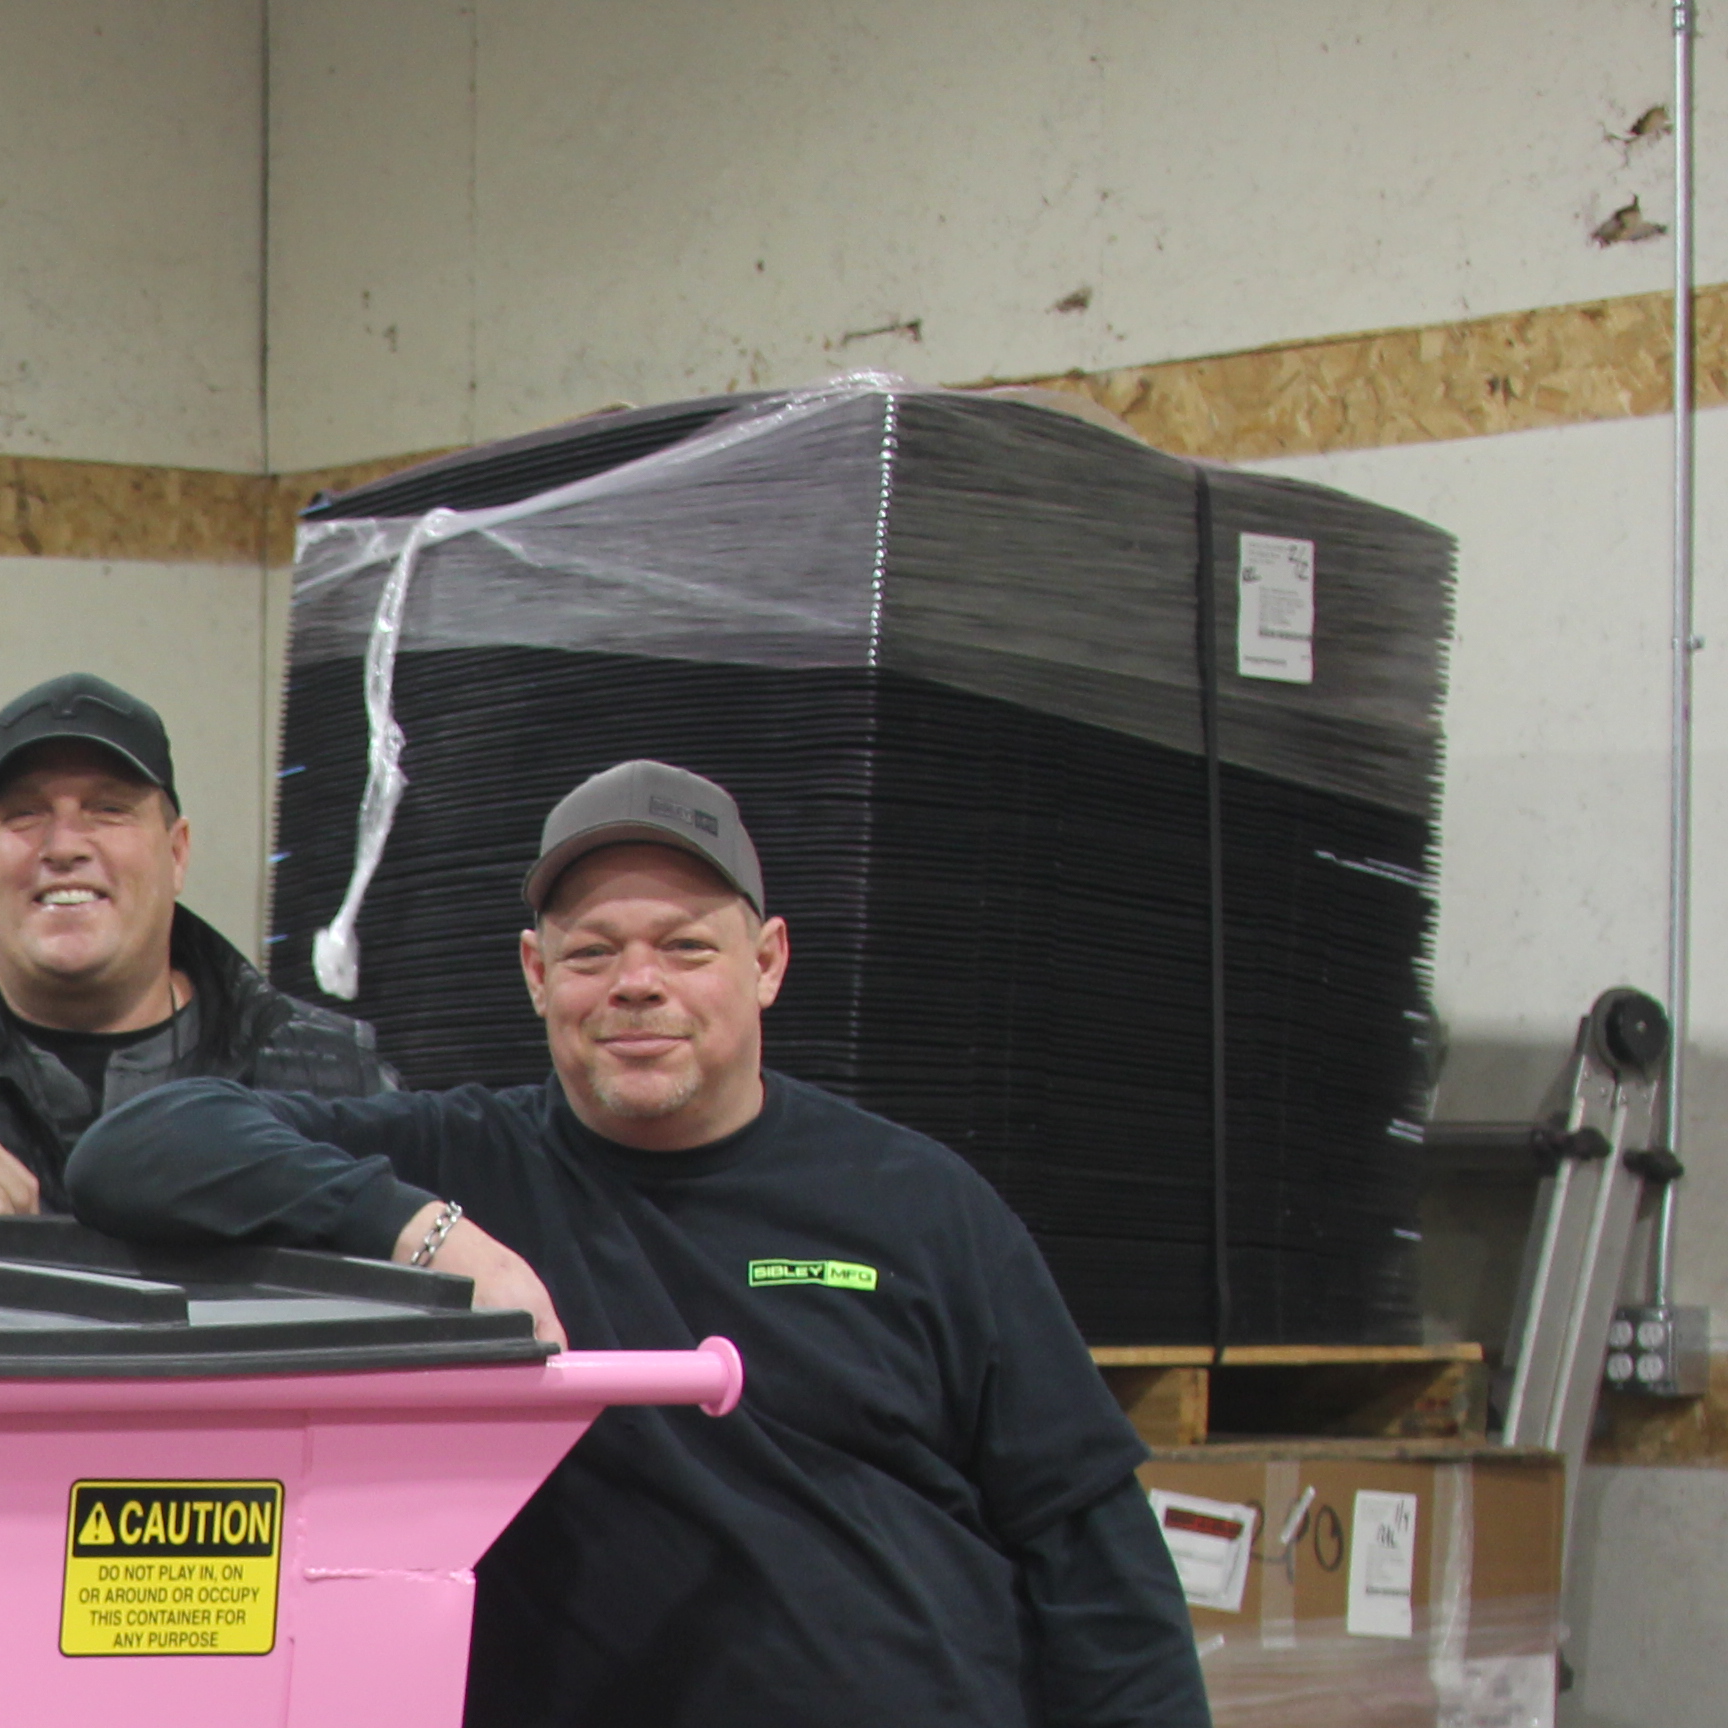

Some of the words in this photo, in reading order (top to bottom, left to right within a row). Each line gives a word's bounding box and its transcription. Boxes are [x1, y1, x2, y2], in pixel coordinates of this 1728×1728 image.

[754, 1265, 823, 1280] SIBLEY
[830, 1267, 872, 1283] MFG
[119, 1500, 272, 1546] CAUTION
[98, 1565, 121, 1582] DO
[124, 1565, 154, 1581] NOT
[158, 1564, 196, 1580] PLAY
[200, 1564, 218, 1583] IN,
[222, 1564, 243, 1580] ON
[78, 1587, 100, 1604] OR
[105, 1587, 168, 1604] AROUND
[172, 1587, 194, 1603] OR
[197, 1586, 261, 1603] OCCUPY
[90, 1609, 122, 1626] THIS
[126, 1609, 210, 1626] CONTAINER
[216, 1609, 246, 1625] FOR
[113, 1631, 144, 1648] ANY
[148, 1631, 219, 1647] PURPOSE
